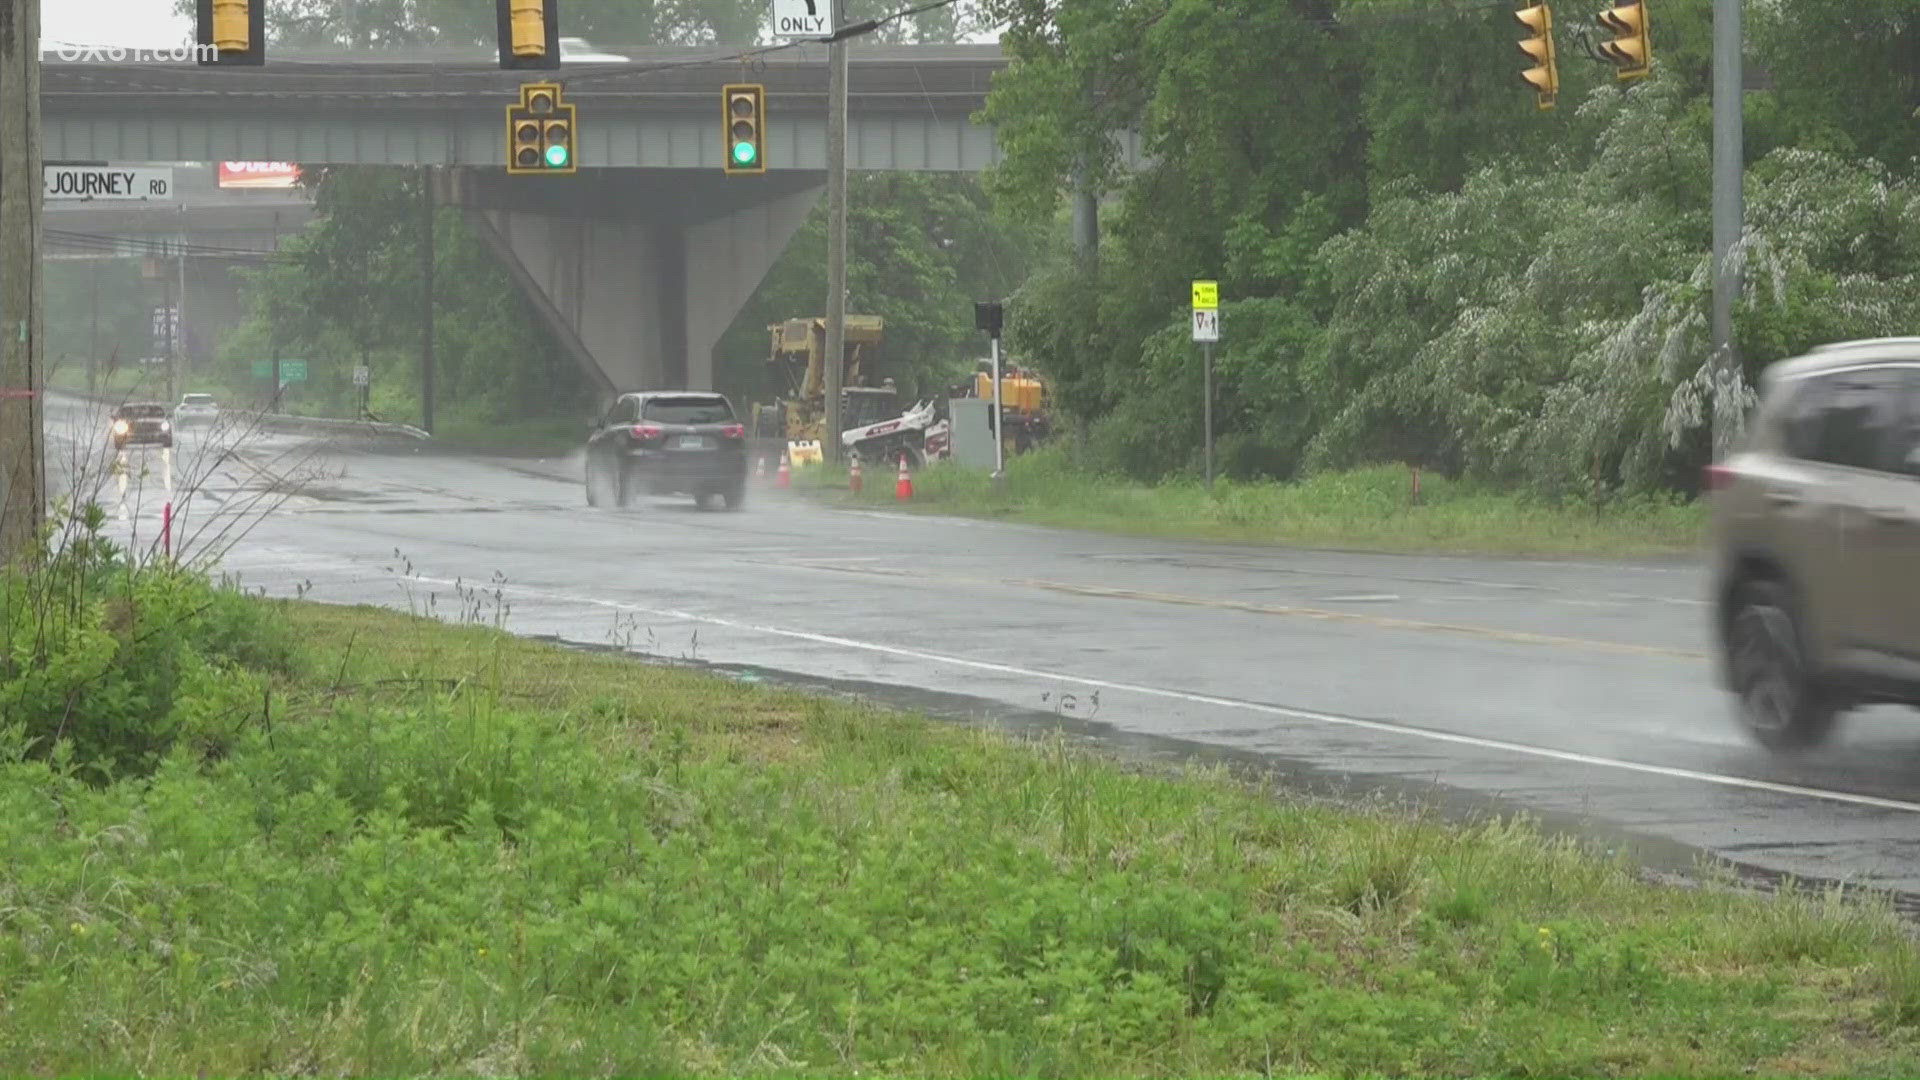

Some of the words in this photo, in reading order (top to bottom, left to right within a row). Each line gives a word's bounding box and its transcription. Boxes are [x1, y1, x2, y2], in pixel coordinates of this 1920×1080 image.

[780, 17, 825, 31] ONLY
[50, 171, 135, 195] JOURNEY
[149, 179, 167, 195] RD
